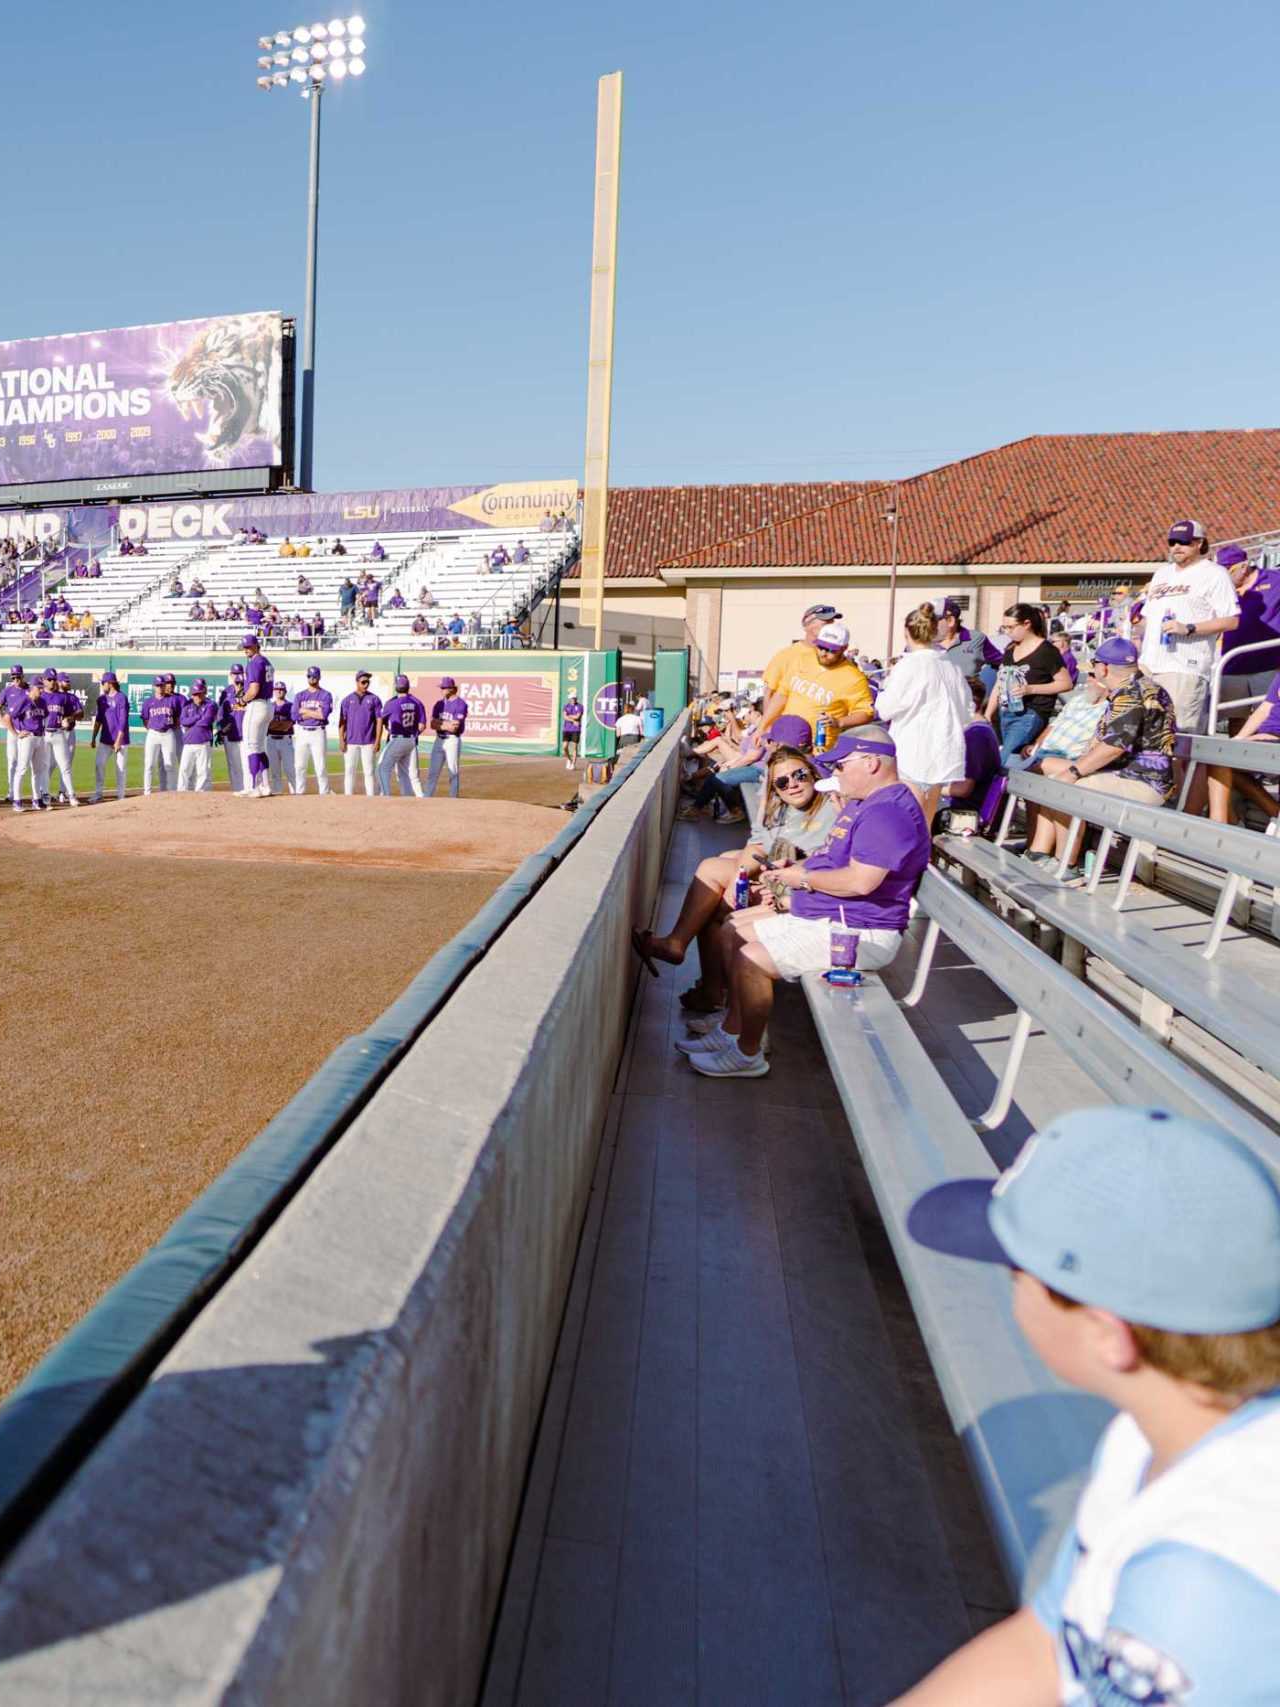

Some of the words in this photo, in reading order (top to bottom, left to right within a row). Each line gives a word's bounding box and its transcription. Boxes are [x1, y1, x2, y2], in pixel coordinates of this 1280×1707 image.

[482, 491, 574, 516] Community
[344, 505, 379, 519] LSU
[120, 504, 234, 538] DECK
[460, 683, 510, 699] FARM
[467, 701, 510, 717] REAU
[465, 722, 509, 732] SURANCE
